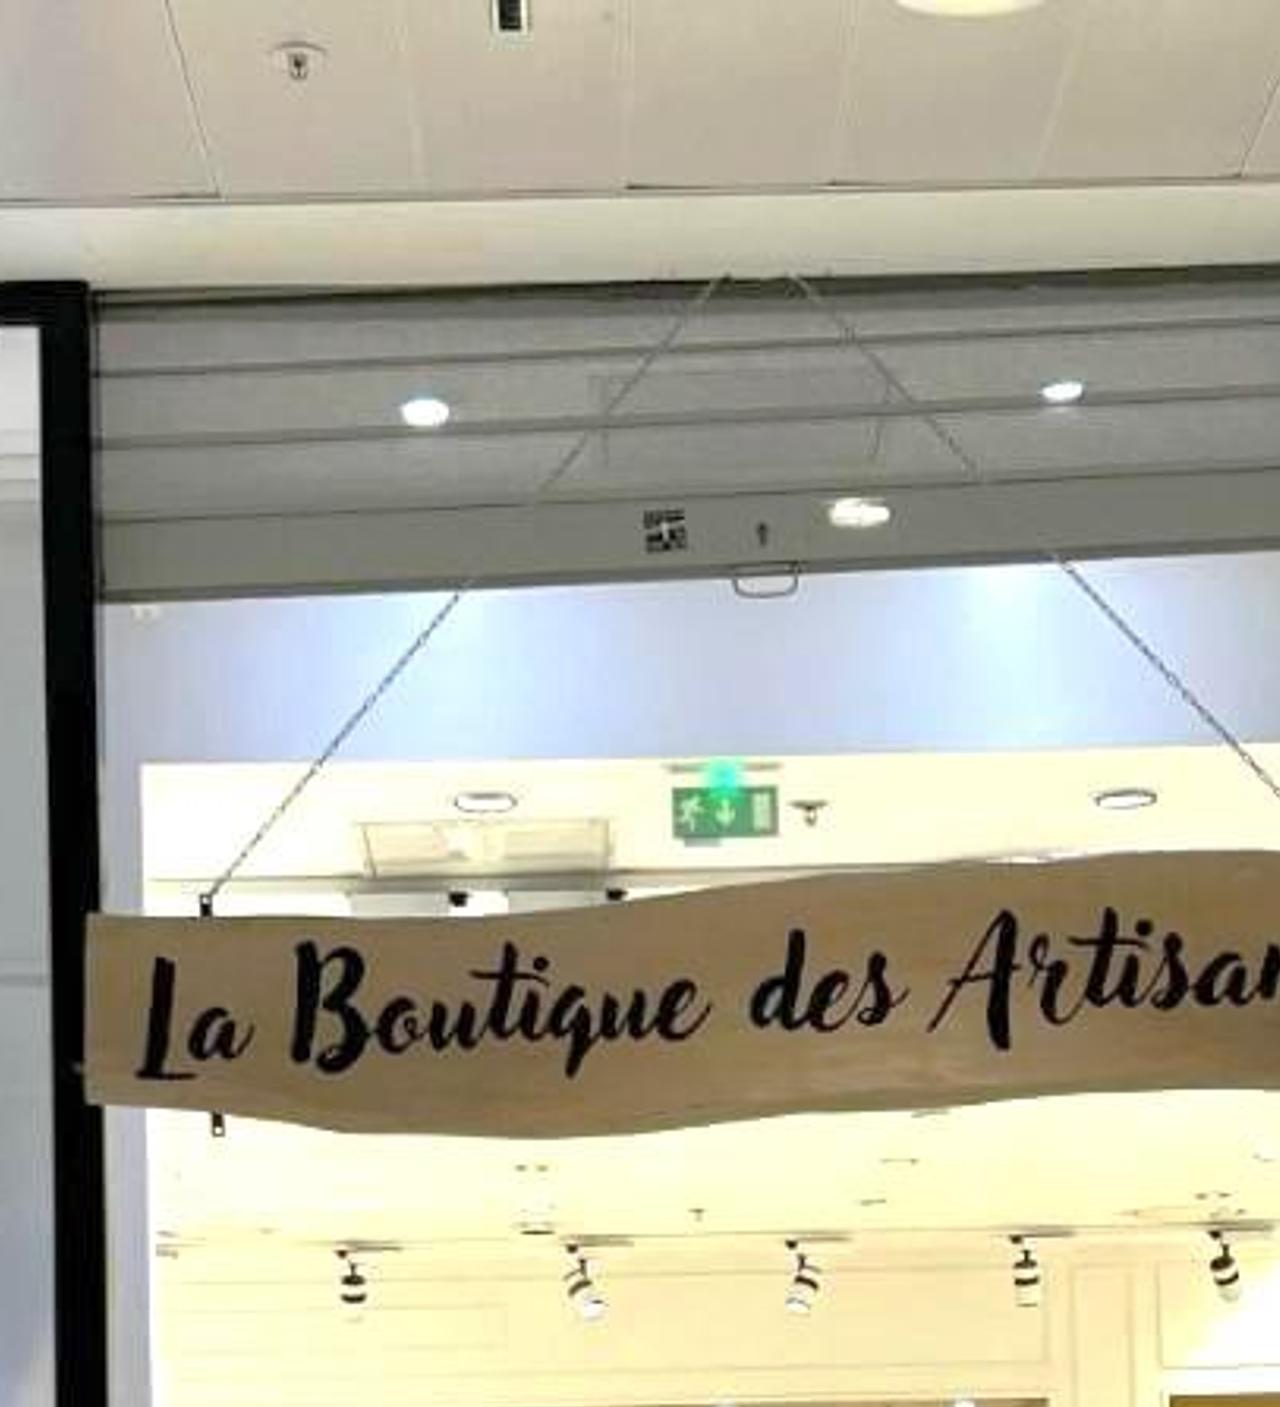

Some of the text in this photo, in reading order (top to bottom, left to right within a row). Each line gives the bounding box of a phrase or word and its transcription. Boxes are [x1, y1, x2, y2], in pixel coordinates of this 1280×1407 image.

[135, 956, 256, 1081] La
[290, 937, 713, 1078] Boutique
[750, 928, 909, 1032] des
